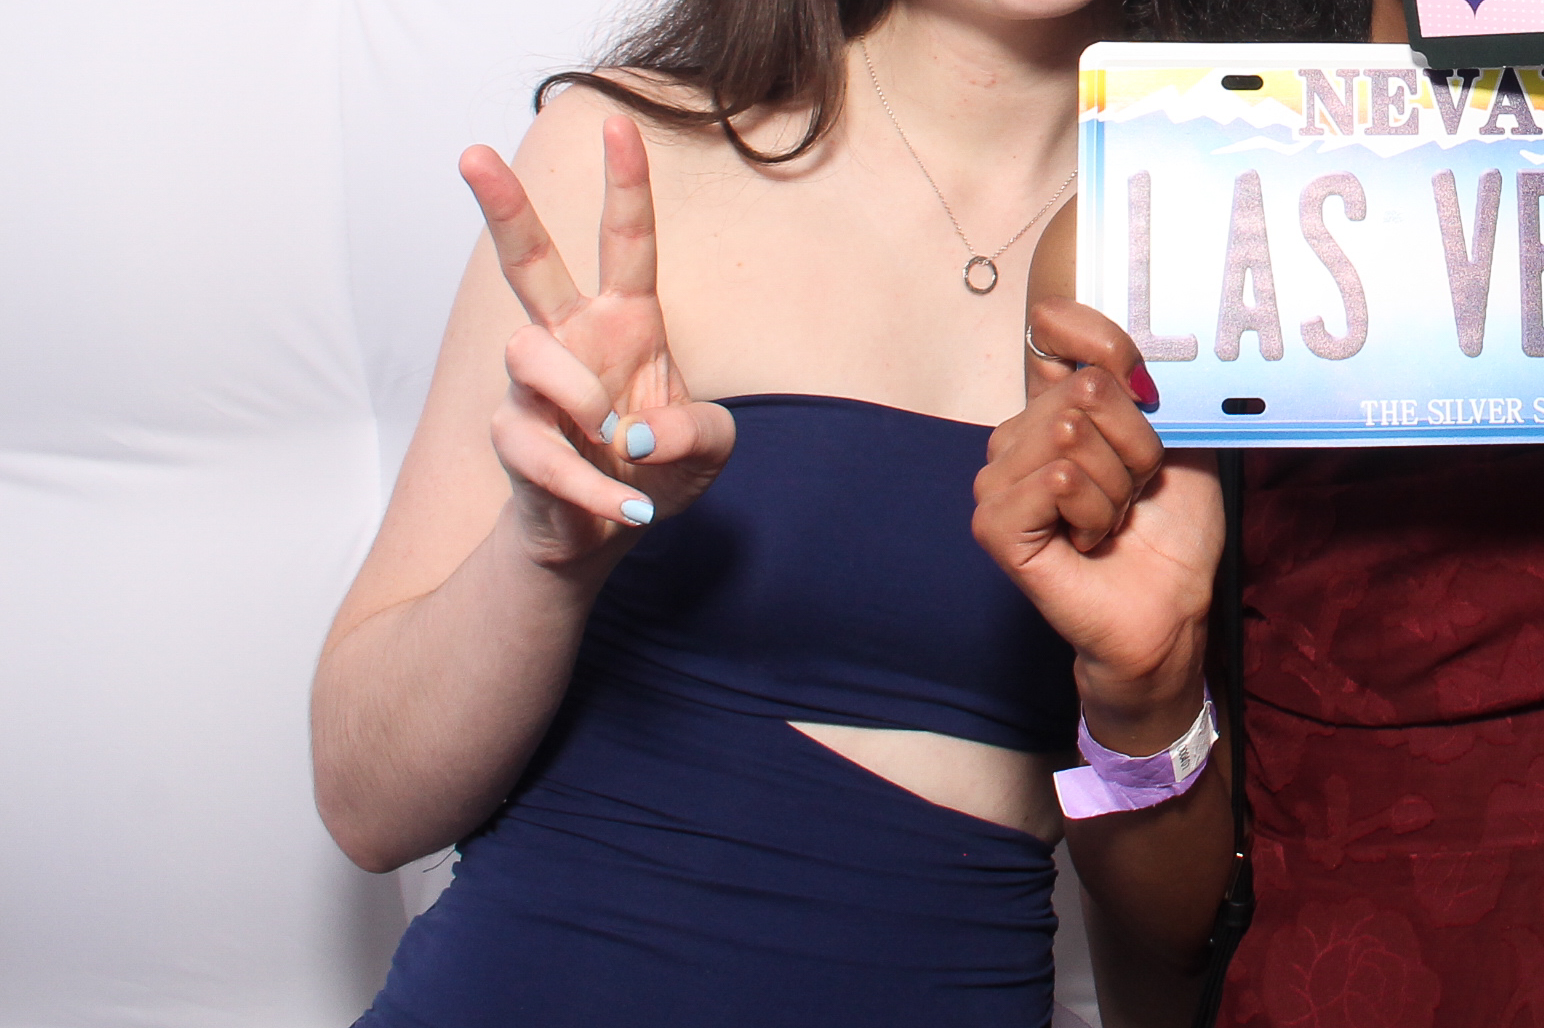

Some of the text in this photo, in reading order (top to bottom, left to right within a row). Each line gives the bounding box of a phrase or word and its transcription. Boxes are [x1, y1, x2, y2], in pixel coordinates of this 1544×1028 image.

[1126, 168, 1370, 363] LAS
[1360, 399, 1419, 427] THE
[1427, 397, 1526, 425] SILVER
